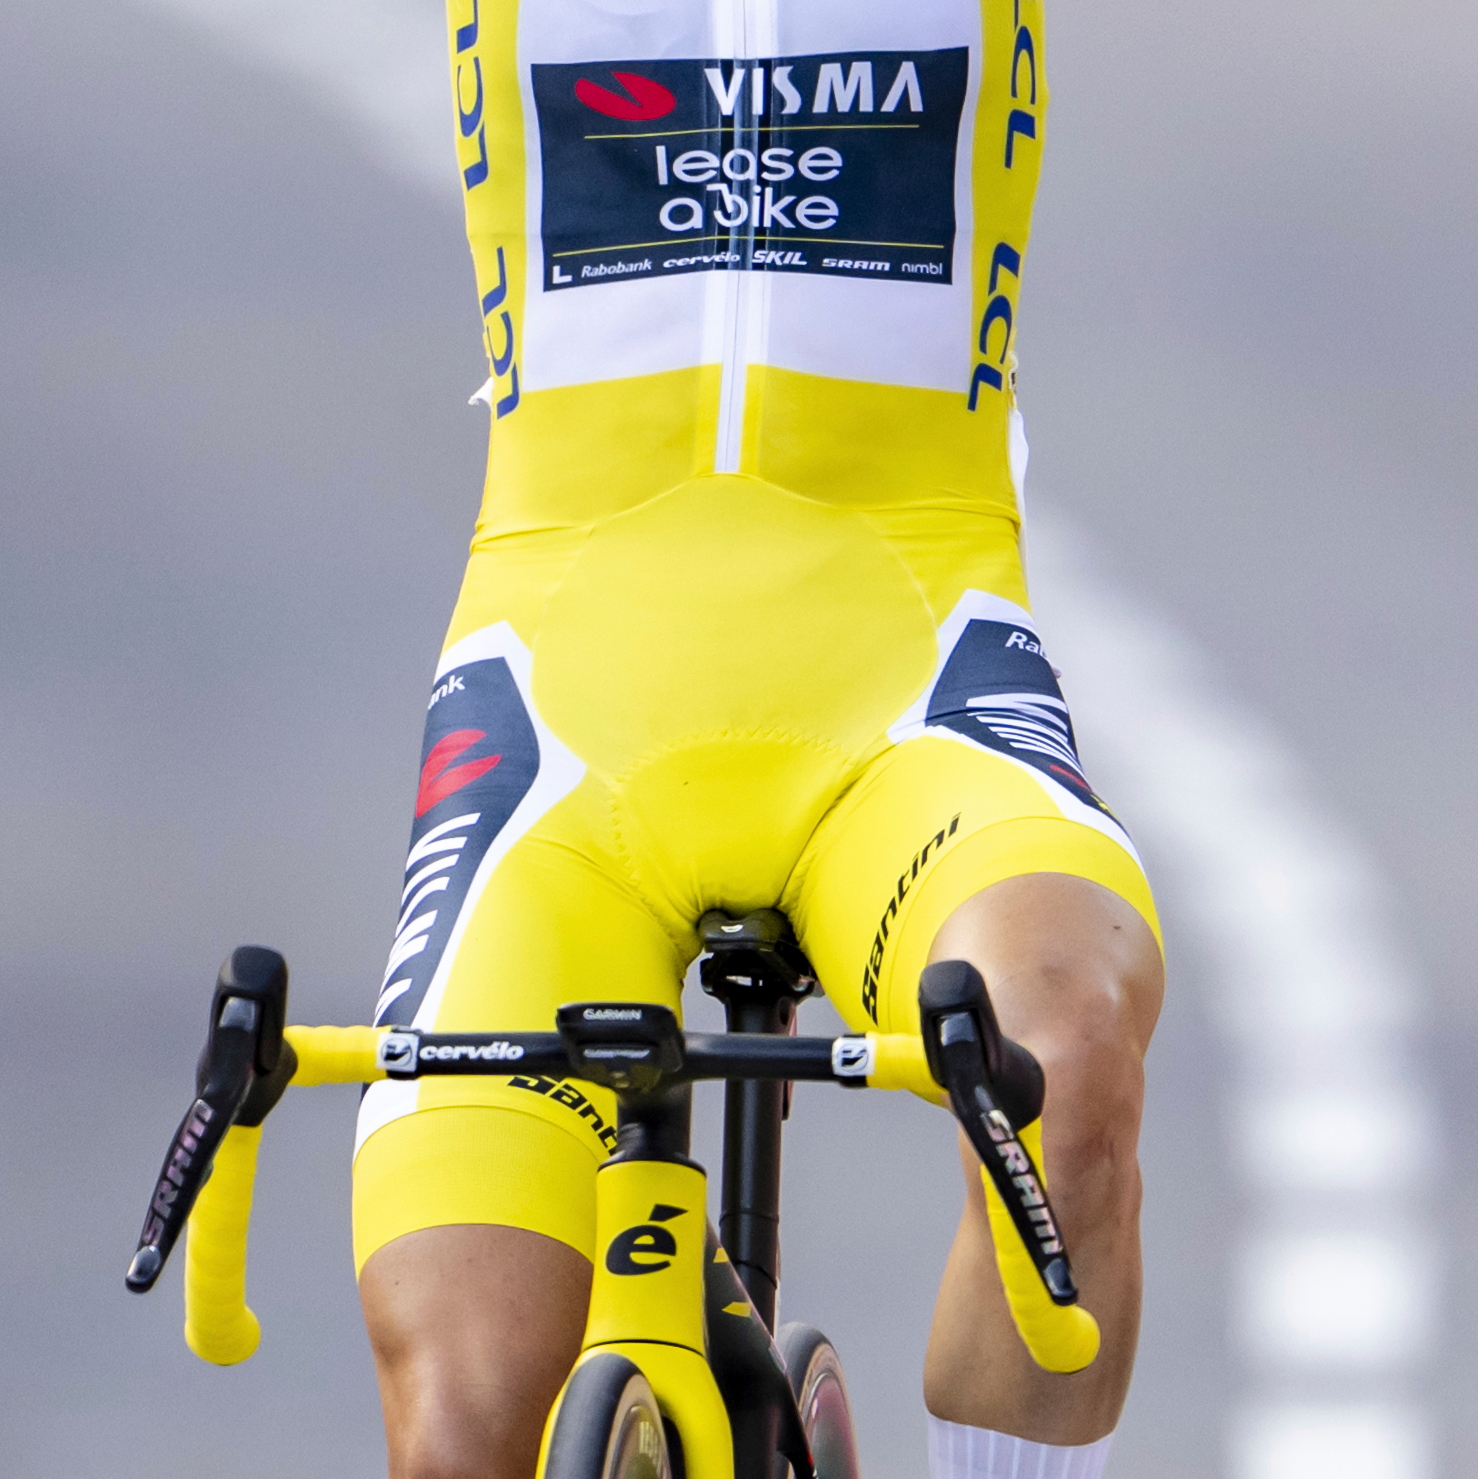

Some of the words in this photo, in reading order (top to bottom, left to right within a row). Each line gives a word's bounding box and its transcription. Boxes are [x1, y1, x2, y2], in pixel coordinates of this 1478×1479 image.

[704, 61, 923, 116] VISMA
[656, 145, 842, 185] lease
[581, 258, 653, 278] Rabobank
[663, 251, 741, 269] cervélo
[752, 250, 808, 266] SKIL
[822, 257, 891, 271] SRAM
[901, 262, 943, 276] nimbl
[481, 246, 519, 419] LCL
[967, 241, 1021, 411] LCL
[861, 811, 962, 1027] Santini
[420, 1041, 525, 1061] cervélo
[583, 1008, 642, 1021] GARMIN
[142, 1098, 215, 1247] SRAM
[980, 1109, 1064, 1255] SRAM
